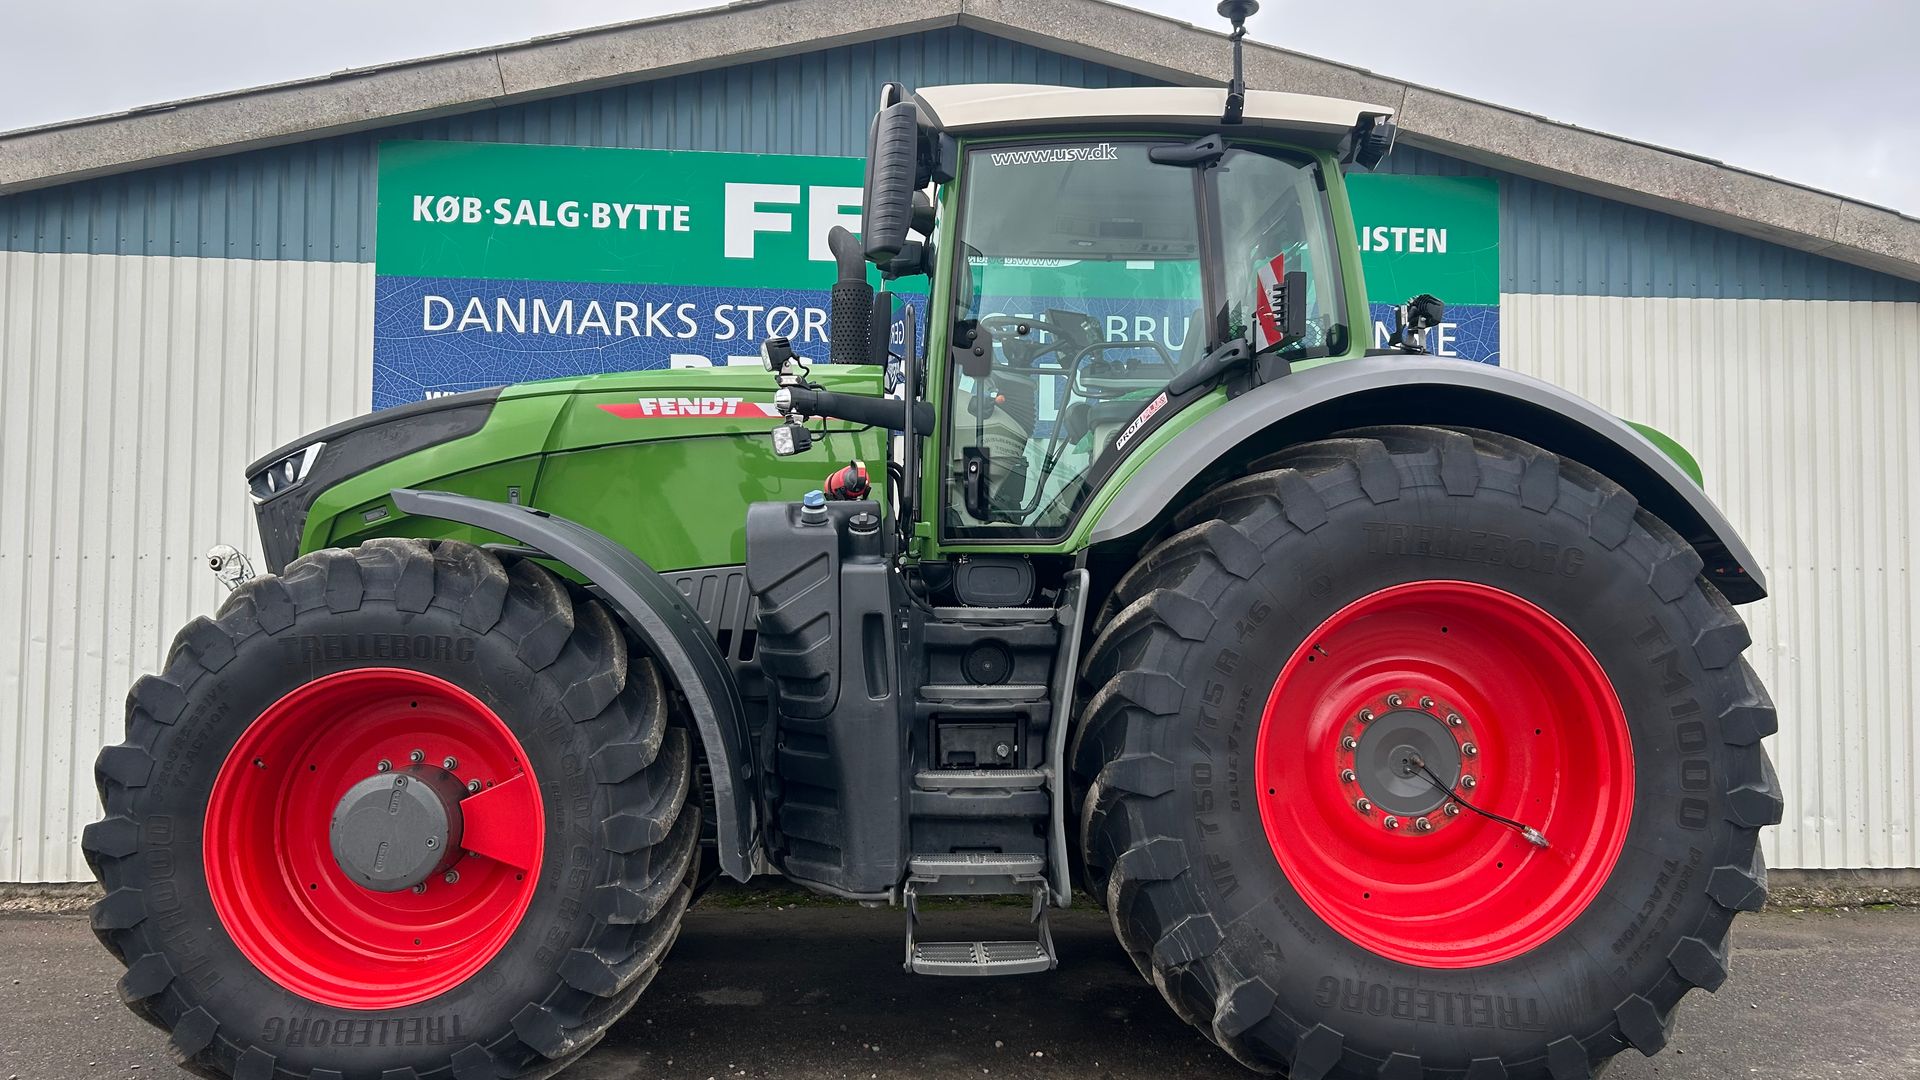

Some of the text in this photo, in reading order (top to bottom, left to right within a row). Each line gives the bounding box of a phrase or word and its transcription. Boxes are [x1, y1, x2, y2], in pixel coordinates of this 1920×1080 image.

[991, 143, 1118, 166] www.usv.dk
[1358, 226, 1447, 253] ISTEN
[423, 295, 699, 339] DANMARKS
[714, 305, 831, 343] STØR
[1106, 315, 1190, 351] BRU
[638, 397, 744, 416] FENDT
[1362, 520, 1588, 579] TRELLEBORG
[277, 632, 478, 665] TRELLEBORG
[1633, 615, 1712, 832] TM1000
[1313, 975, 1551, 1033] TRELLEBORG
[261, 1014, 467, 1048] TRELLEBORG
